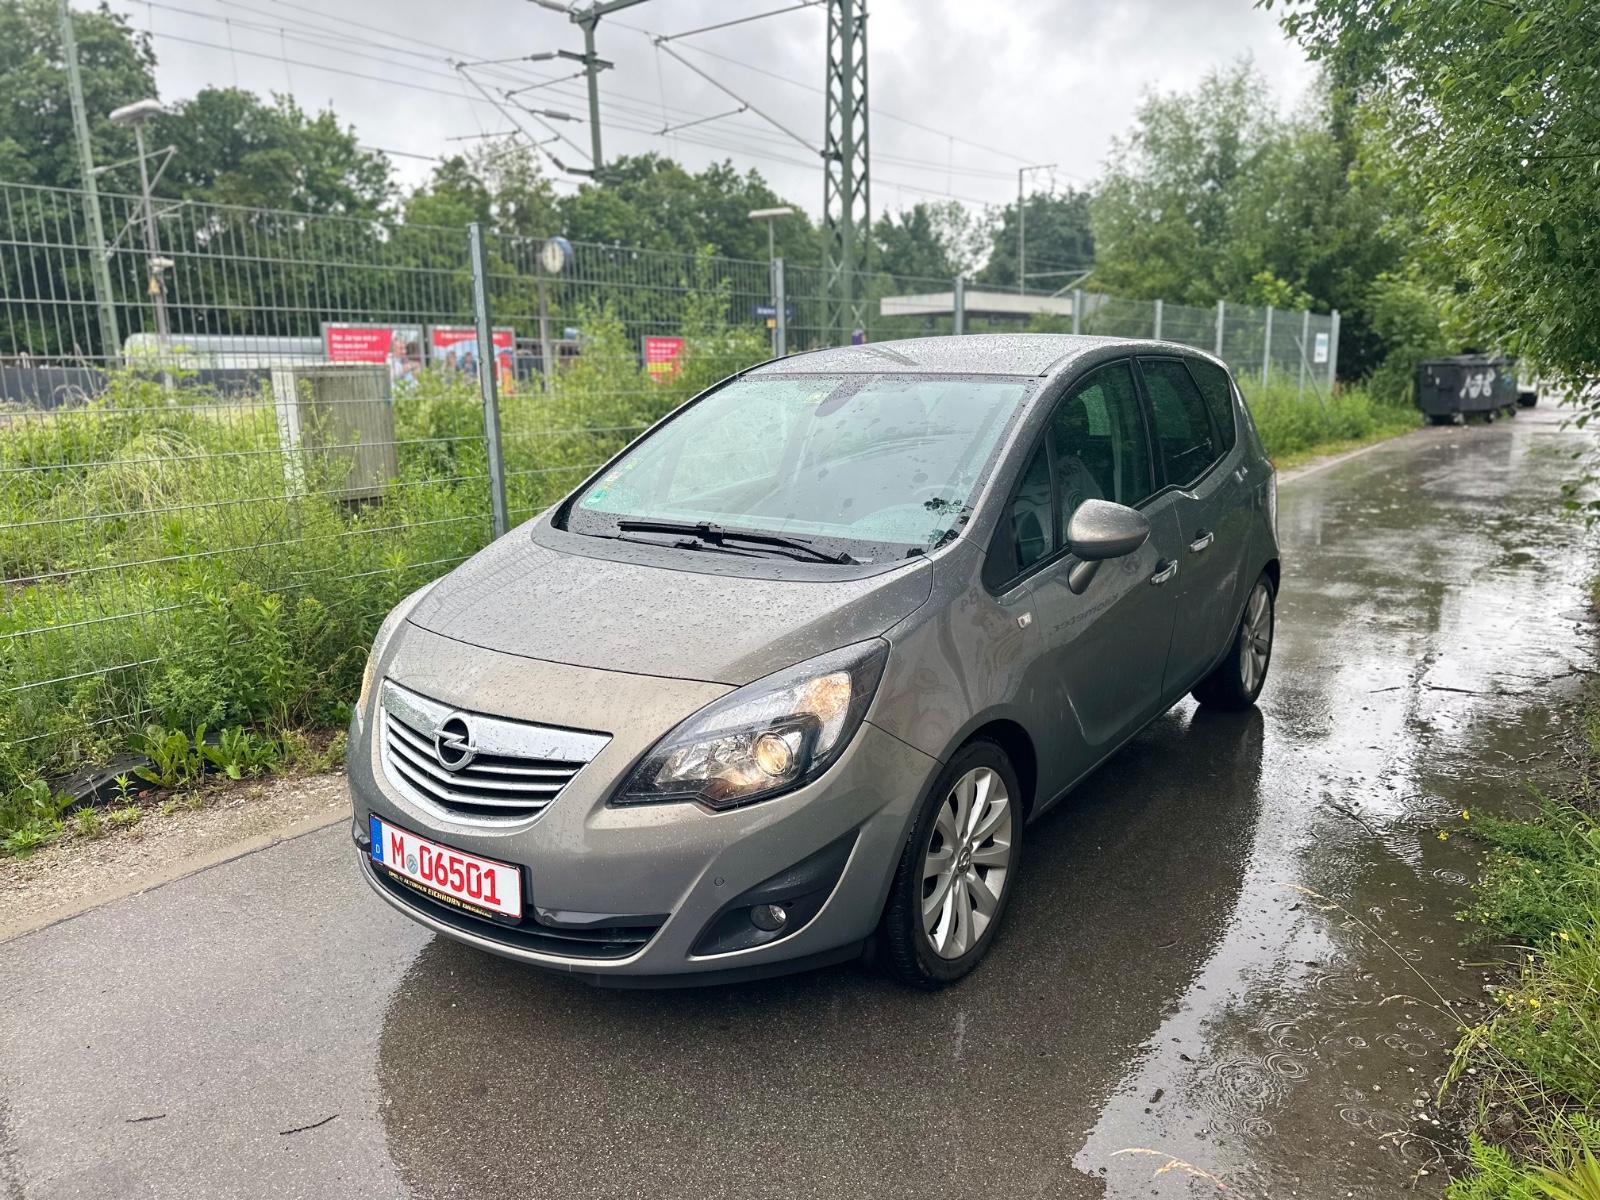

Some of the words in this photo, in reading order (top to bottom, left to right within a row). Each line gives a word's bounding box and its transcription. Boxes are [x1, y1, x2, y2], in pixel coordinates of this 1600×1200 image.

[375, 844, 381, 854] D
[391, 831, 405, 869] M
[419, 845, 501, 905] 06501
[427, 888, 461, 907] EICHHORN
